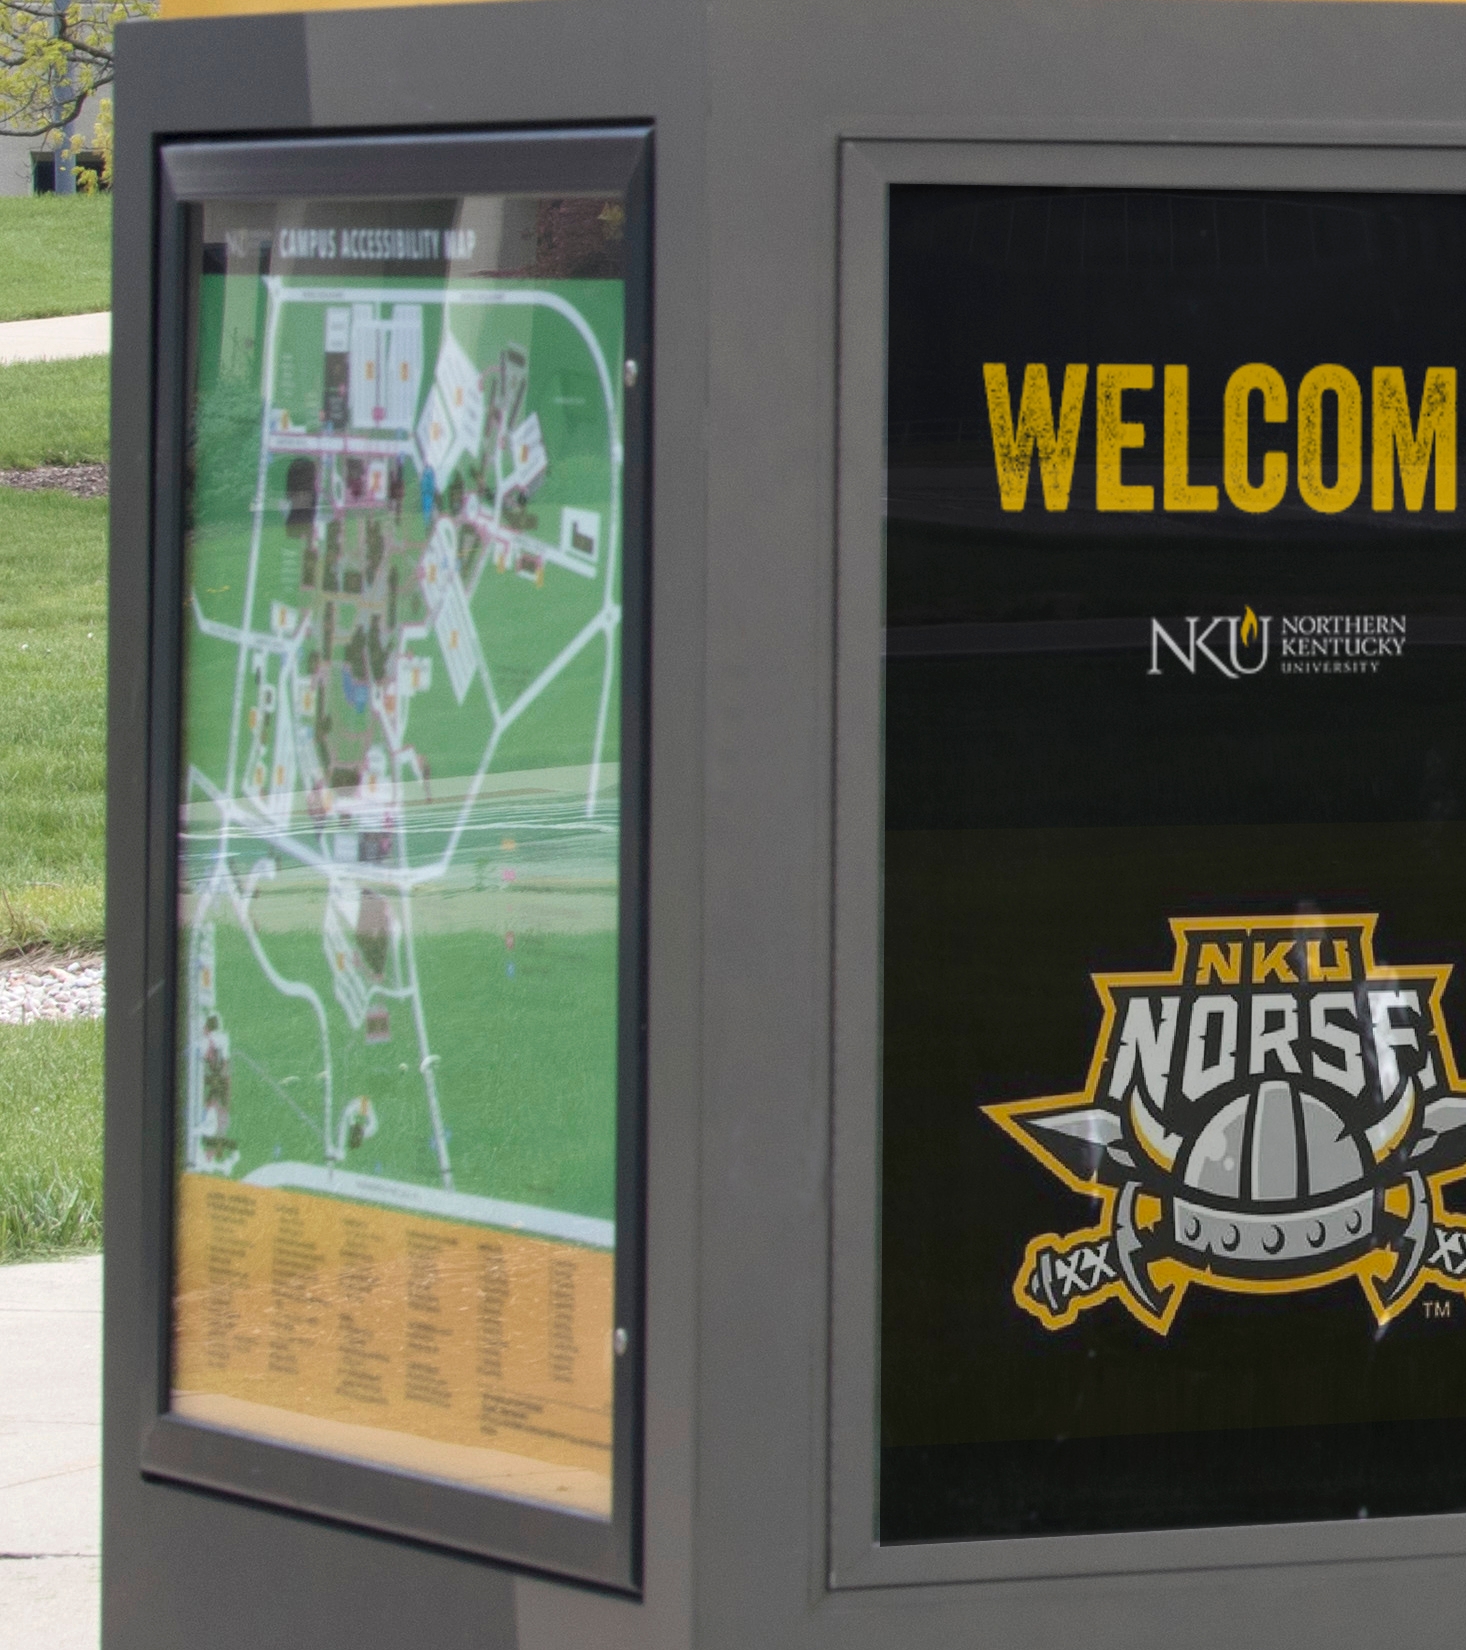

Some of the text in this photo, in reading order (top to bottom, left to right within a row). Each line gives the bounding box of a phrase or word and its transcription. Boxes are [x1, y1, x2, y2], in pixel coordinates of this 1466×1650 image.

[278, 228, 336, 259] CAMPUS
[341, 228, 441, 260] ACCESSIBILITY
[444, 229, 477, 260] MAP
[1281, 615, 1406, 636] NORTHERN
[1147, 615, 1273, 679] NKU
[1281, 637, 1406, 657] KENTUCKY
[1281, 660, 1380, 674] UNIVERSITY
[1196, 938, 1352, 986] NKU
[1107, 991, 1438, 1110] NORSE
[1423, 1302, 1451, 1319] TM
